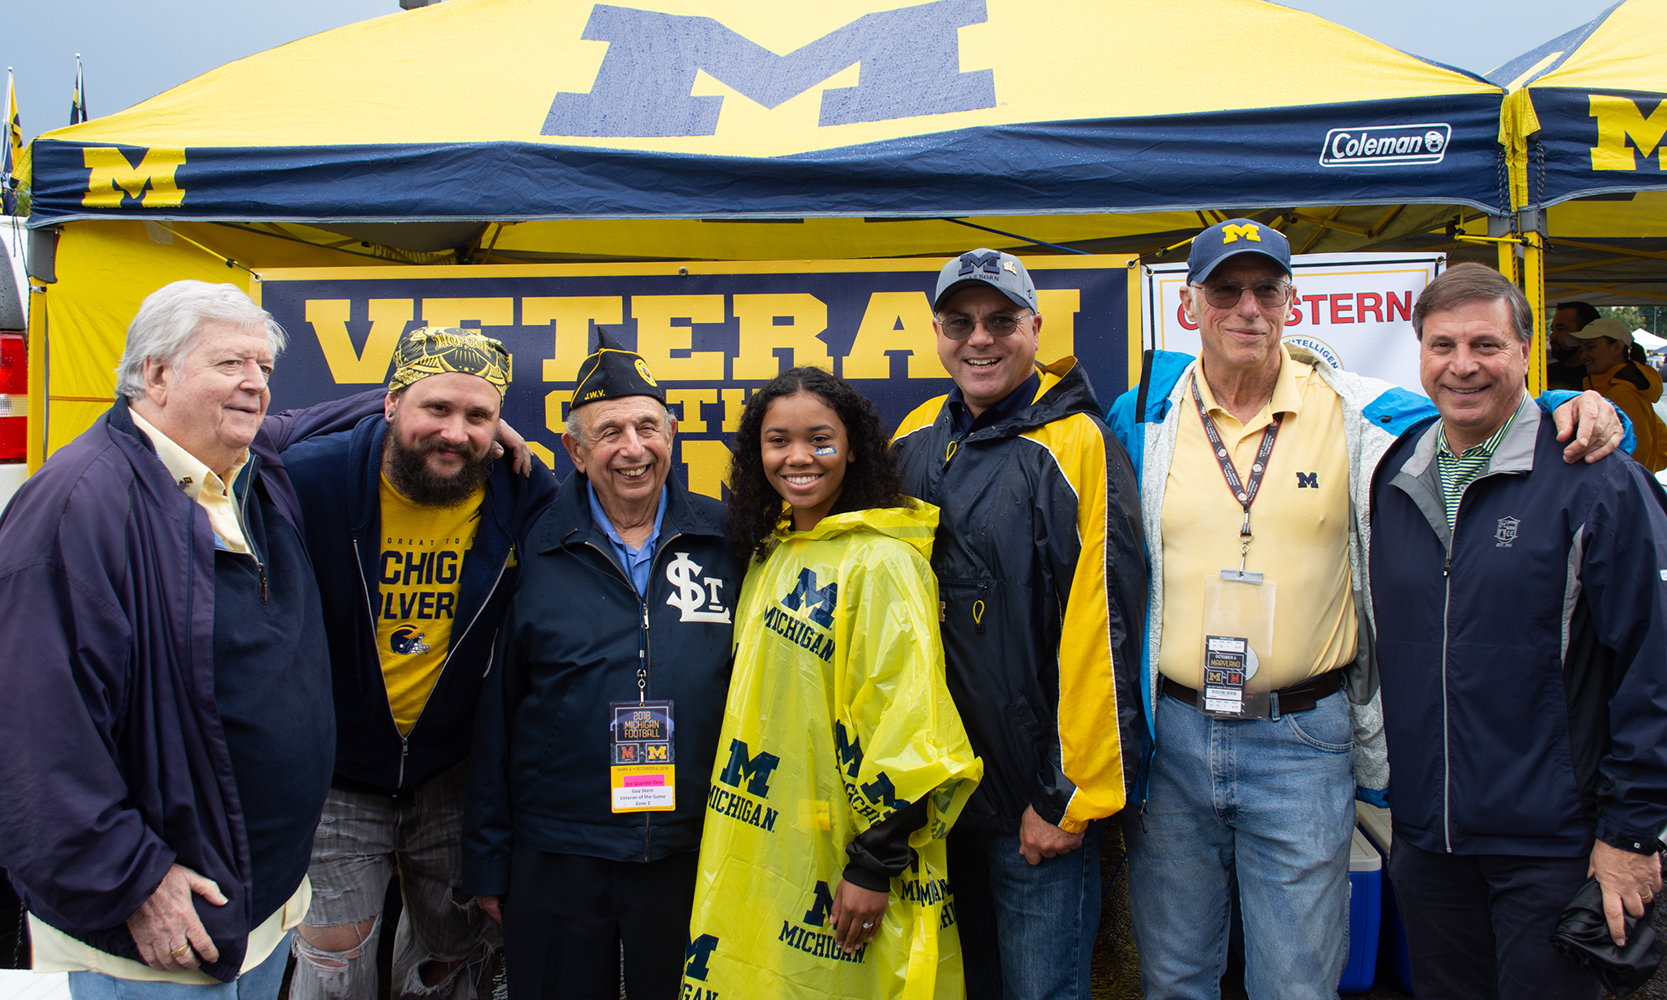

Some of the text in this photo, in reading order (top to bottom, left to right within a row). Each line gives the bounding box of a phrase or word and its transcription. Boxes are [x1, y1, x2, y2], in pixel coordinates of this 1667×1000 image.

[540, 0, 996, 137] M
[1331, 132, 1423, 159] Coleman
[82, 147, 187, 208] M
[1222, 223, 1261, 244] M
[958, 252, 1001, 276] M
[1289, 338, 1339, 369] TELLIGEN
[584, 389, 606, 401] J.W.V.
[1296, 472, 1319, 489] M
[387, 537, 460, 546] GREAT TO
[379, 550, 470, 585] CHIG
[781, 567, 838, 630] M
[764, 605, 835, 663] MICHIGAN
[1211, 659, 1241, 668] MARYLAND
[1209, 672, 1221, 682] M
[624, 720, 660, 729] MICHIGAN
[633, 711, 651, 720] 2018
[624, 729, 660, 738] FOOTBALL
[621, 746, 634, 760] M
[648, 746, 667, 760] M
[720, 738, 780, 799] M
